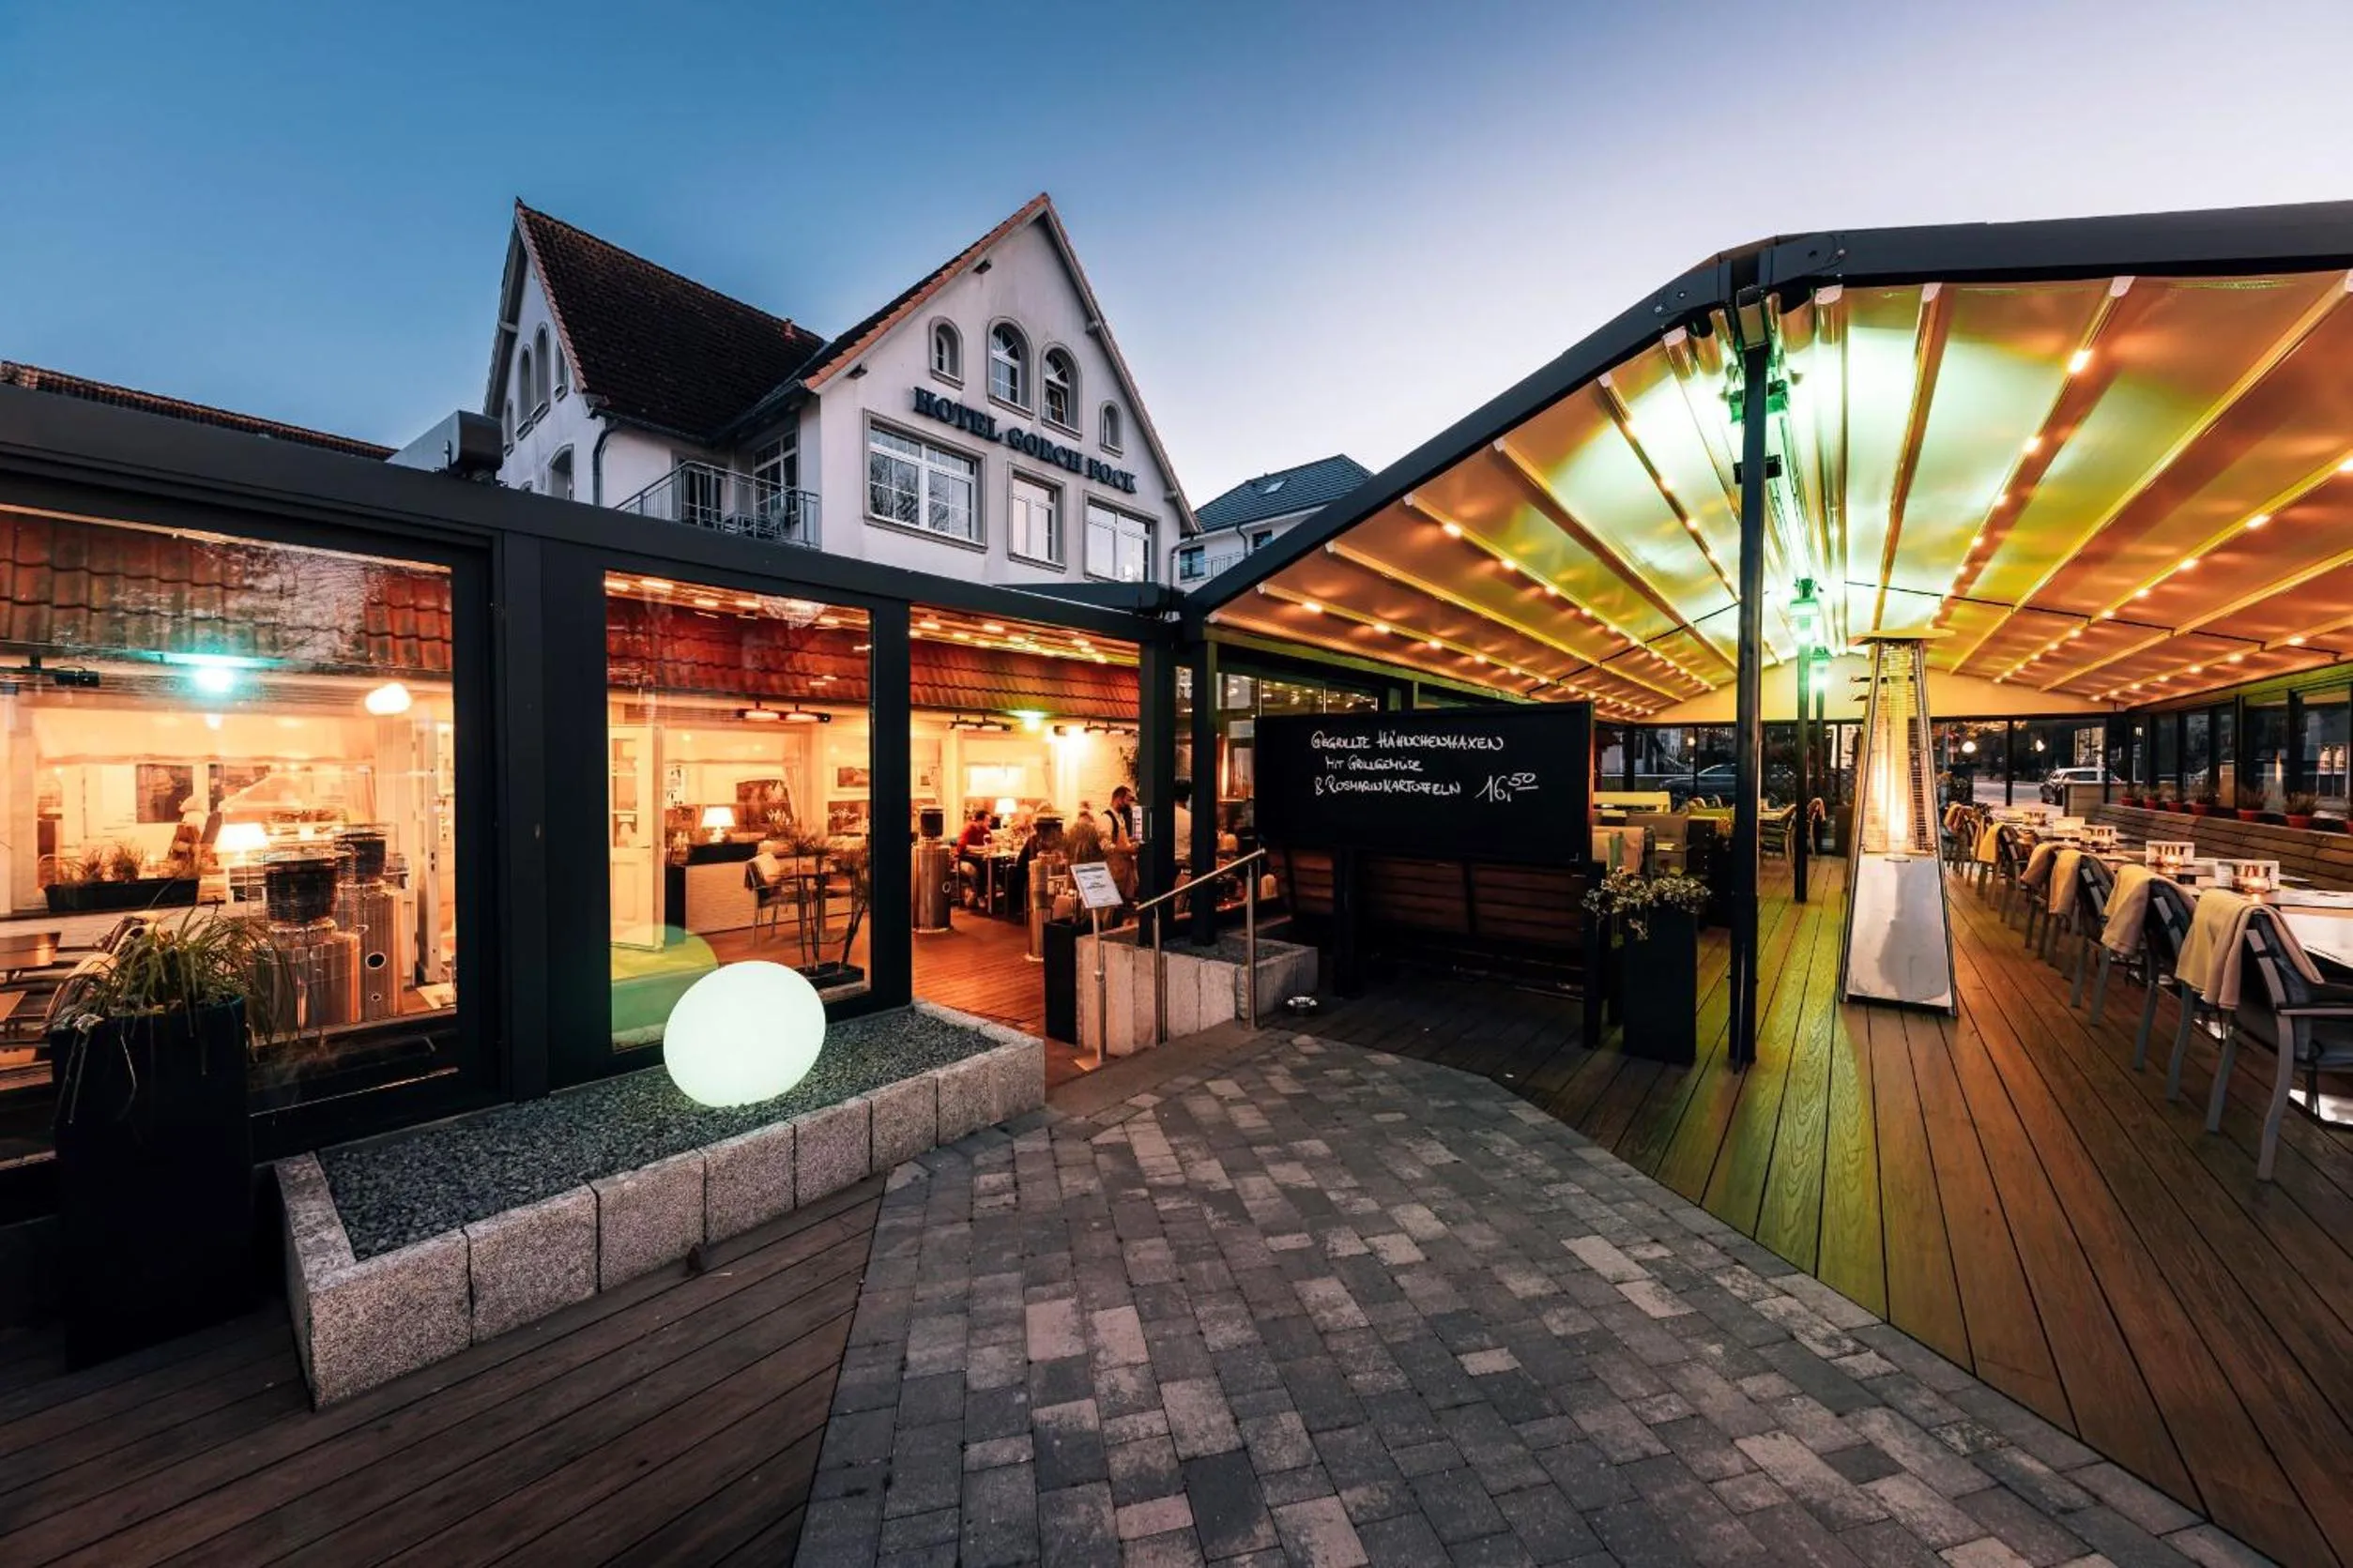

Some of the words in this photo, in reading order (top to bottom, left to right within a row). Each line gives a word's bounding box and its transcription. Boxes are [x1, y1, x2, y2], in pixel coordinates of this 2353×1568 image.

[913, 387, 1002, 442] HOTEL
[1007, 427, 1080, 474] GORCH
[1085, 456, 1137, 495] FOCK
[1315, 776, 1324, 797] &
